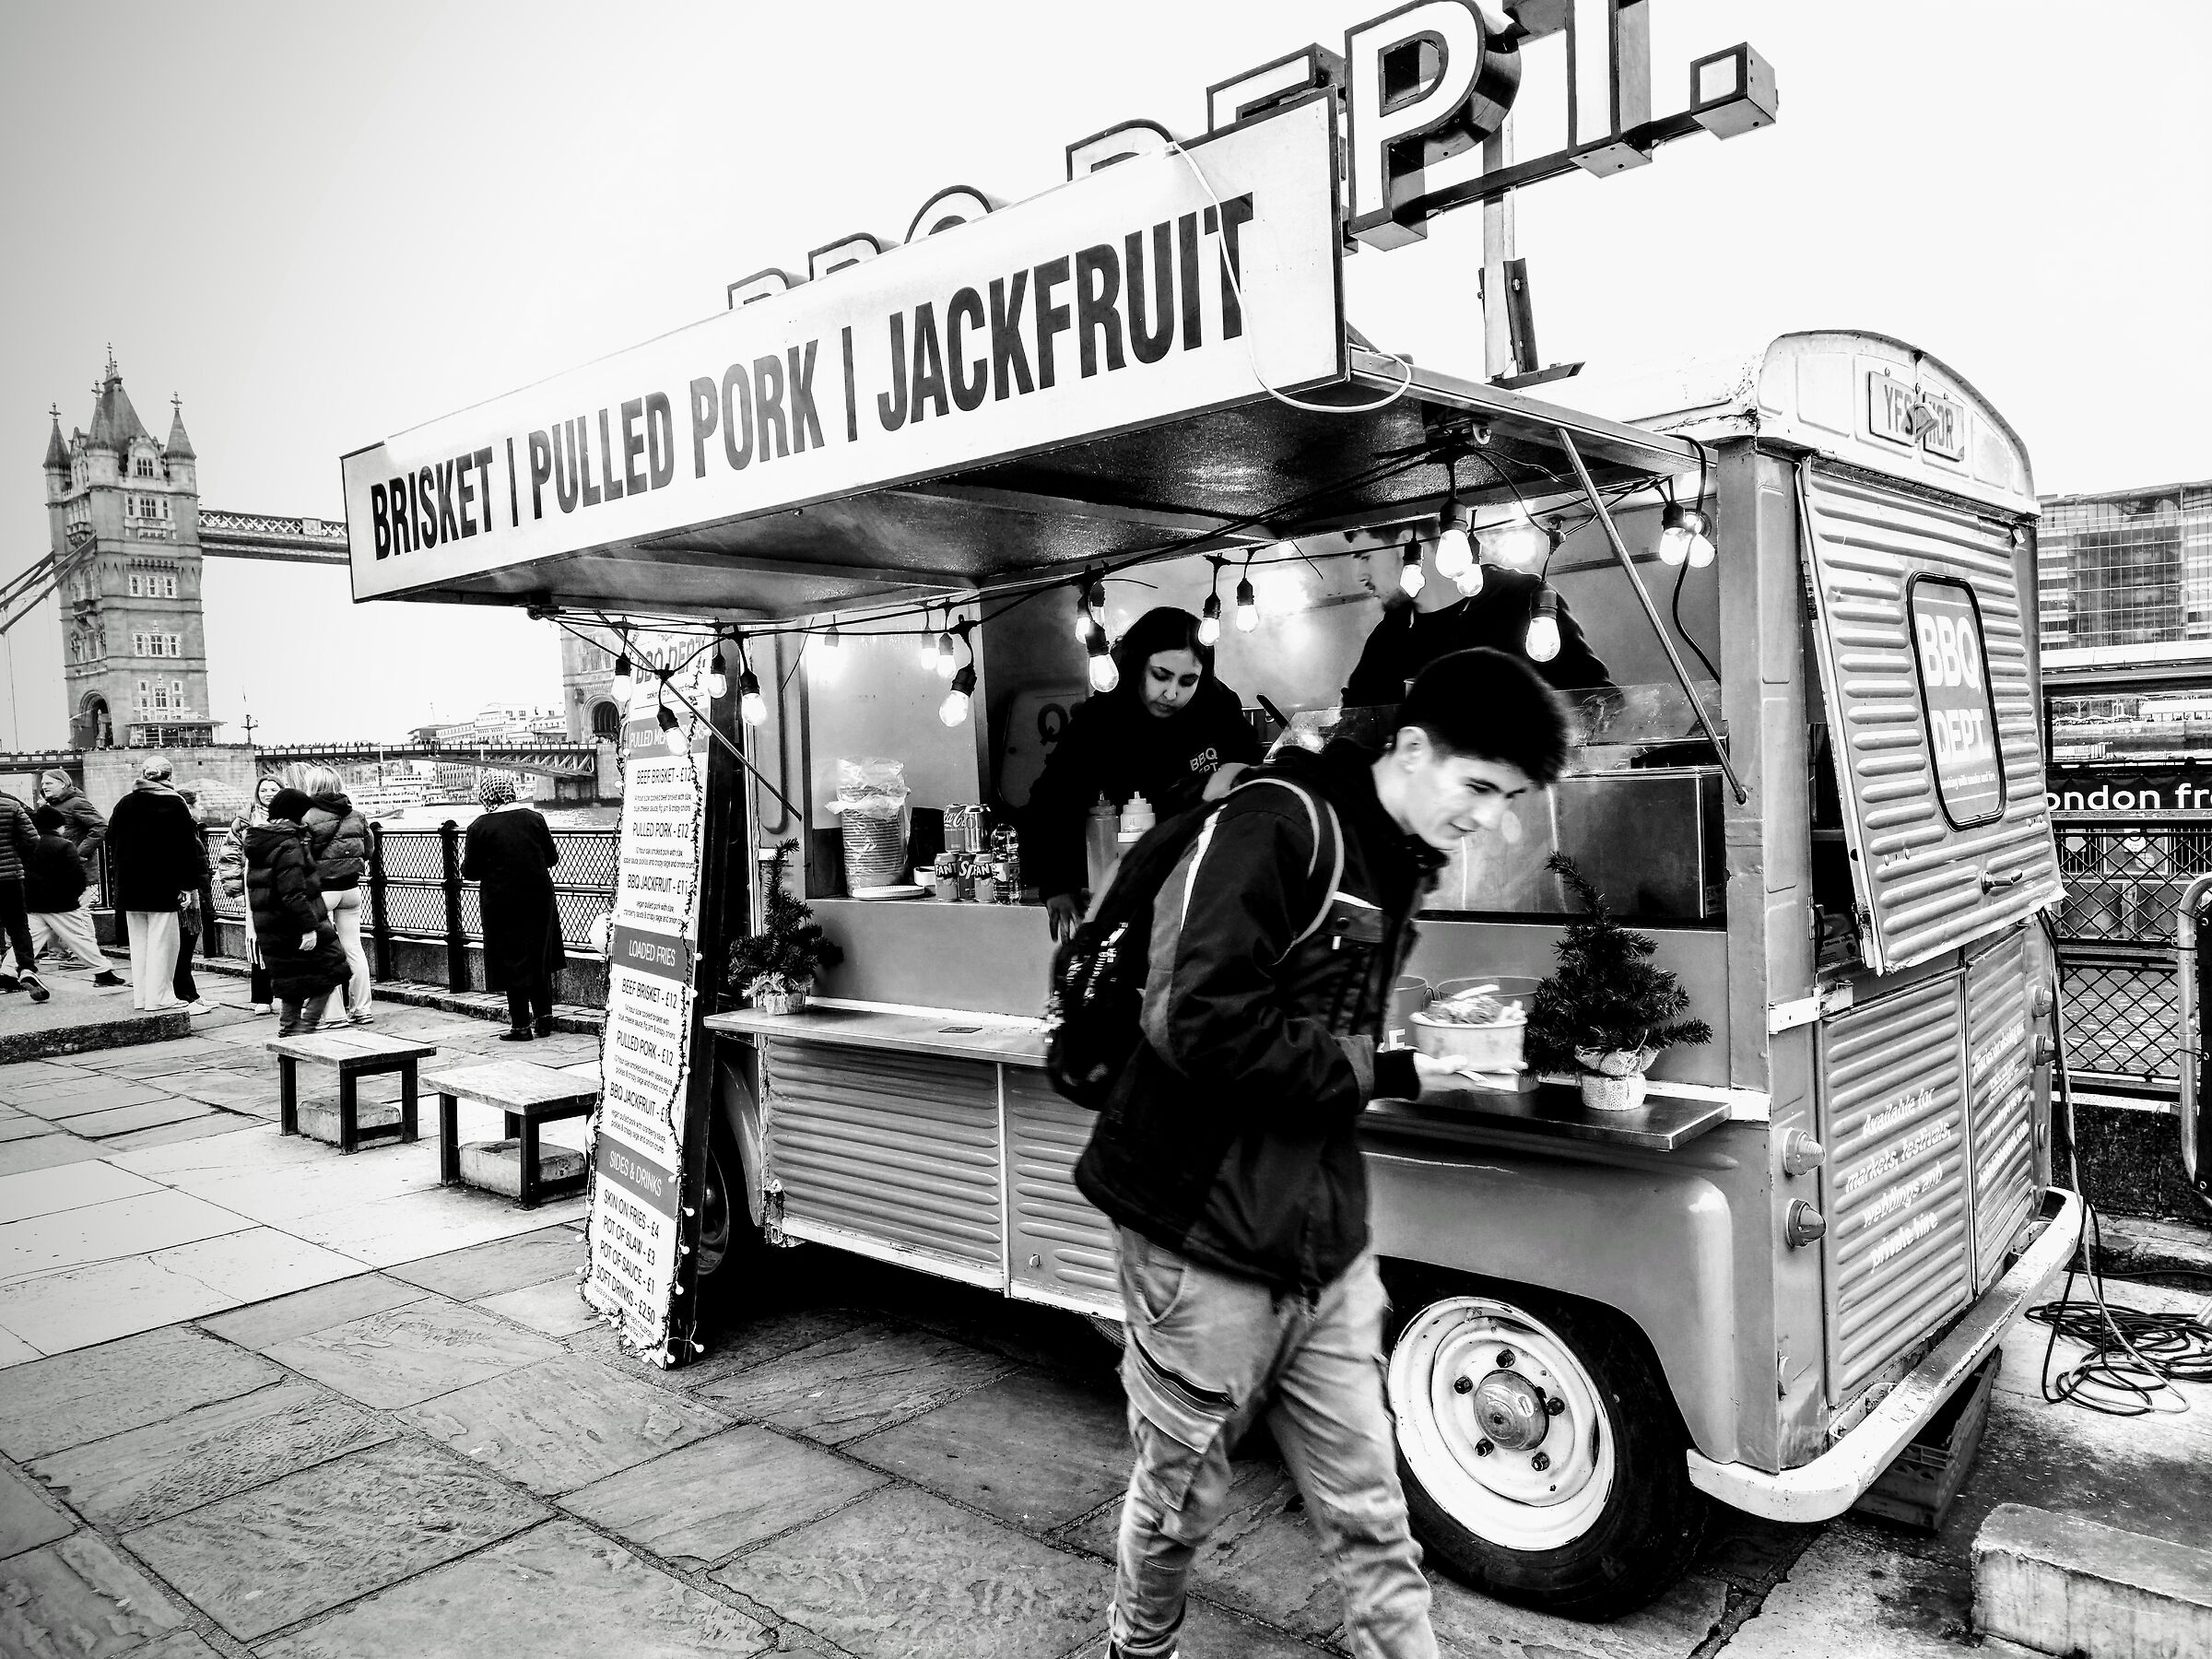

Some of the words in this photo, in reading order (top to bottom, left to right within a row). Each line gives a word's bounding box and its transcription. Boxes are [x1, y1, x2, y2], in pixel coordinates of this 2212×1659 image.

[371, 446, 494, 561] BRISKET
[528, 391, 674, 520] PULLED
[689, 328, 825, 479] PORK
[876, 192, 1255, 433] JACKFRUIT
[1916, 612, 1982, 693] BBQ
[630, 729, 653, 747] PULLED
[636, 770, 651, 784] BEEF
[652, 767, 676, 783] BRISKET
[1189, 747, 1218, 771] BBQ
[2174, 782, 2212, 810] fr
[632, 822, 654, 837] PULLED
[655, 822, 673, 838] PORK
[628, 874, 640, 889] BBQ
[641, 875, 673, 893] JACKFRUIT
[629, 939, 655, 961] LOADED
[656, 946, 676, 966] FRIES
[622, 978, 636, 995] BEEF
[637, 982, 661, 1004] BRISKET
[665, 992, 677, 1009] £12
[617, 1030, 640, 1052] PULLED
[640, 1039, 657, 1060] PORK
[662, 1049, 674, 1066] £12
[610, 1081, 623, 1100] BBQ
[623, 1088, 656, 1117] JACKFRUIT
[1862, 1091, 1916, 1139] Available
[1916, 1087, 1936, 1109] for
[609, 1150, 629, 1177] SIDES
[629, 1162, 634, 1180] &
[635, 1165, 662, 1197] DRINKS
[604, 1189, 618, 1210] SKIN
[618, 1198, 629, 1218] ON
[629, 1205, 646, 1230] FRIES
[651, 1221, 659, 1239] £4
[1862, 1180, 1921, 1229] weddings
[1921, 1160, 1944, 1193] and
[604, 1215, 616, 1236] POT
[616, 1224, 626, 1241] OF
[626, 1230, 642, 1255] SLAW
[647, 1247, 655, 1265] £3
[1870, 1230, 1915, 1274] private
[1914, 1209, 1939, 1242] hire
[600, 1240, 612, 1260] POT
[612, 1249, 621, 1266] OF
[621, 1256, 642, 1285] SAUCE
[647, 1277, 654, 1295] £1
[596, 1264, 611, 1288] SOFT
[611, 1276, 633, 1307] DRINKS
[638, 1300, 655, 1325] £2.50
